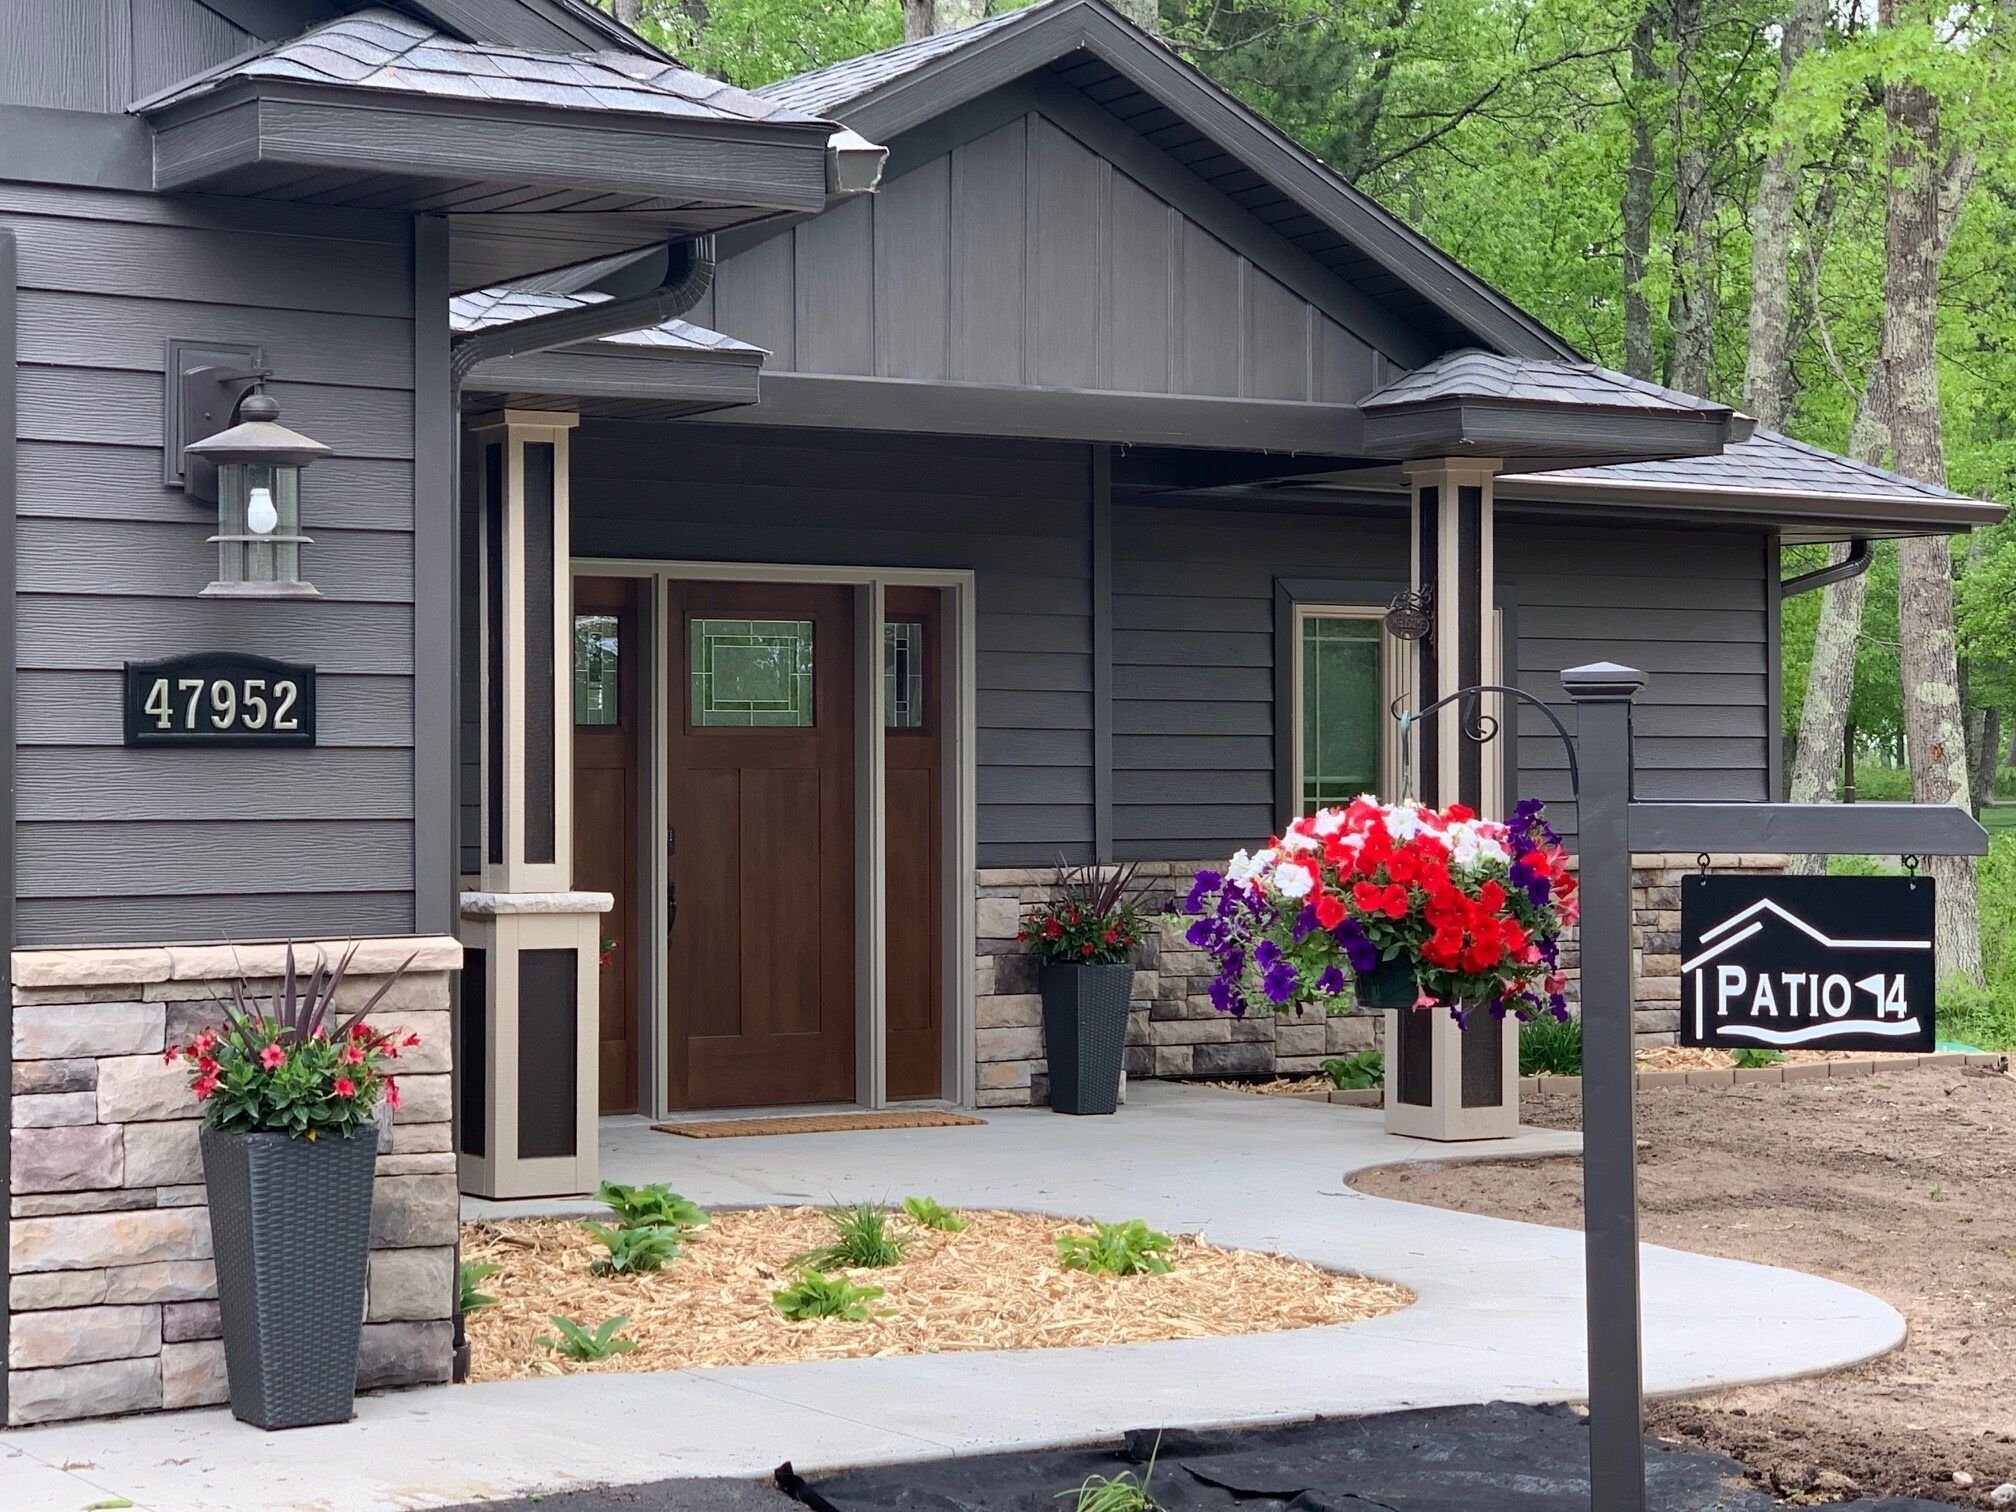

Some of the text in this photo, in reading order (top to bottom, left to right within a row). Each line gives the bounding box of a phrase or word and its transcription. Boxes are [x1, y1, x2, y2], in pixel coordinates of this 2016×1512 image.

[144, 678, 298, 730] 47952
[1717, 965, 1908, 1019] PATIO 14
